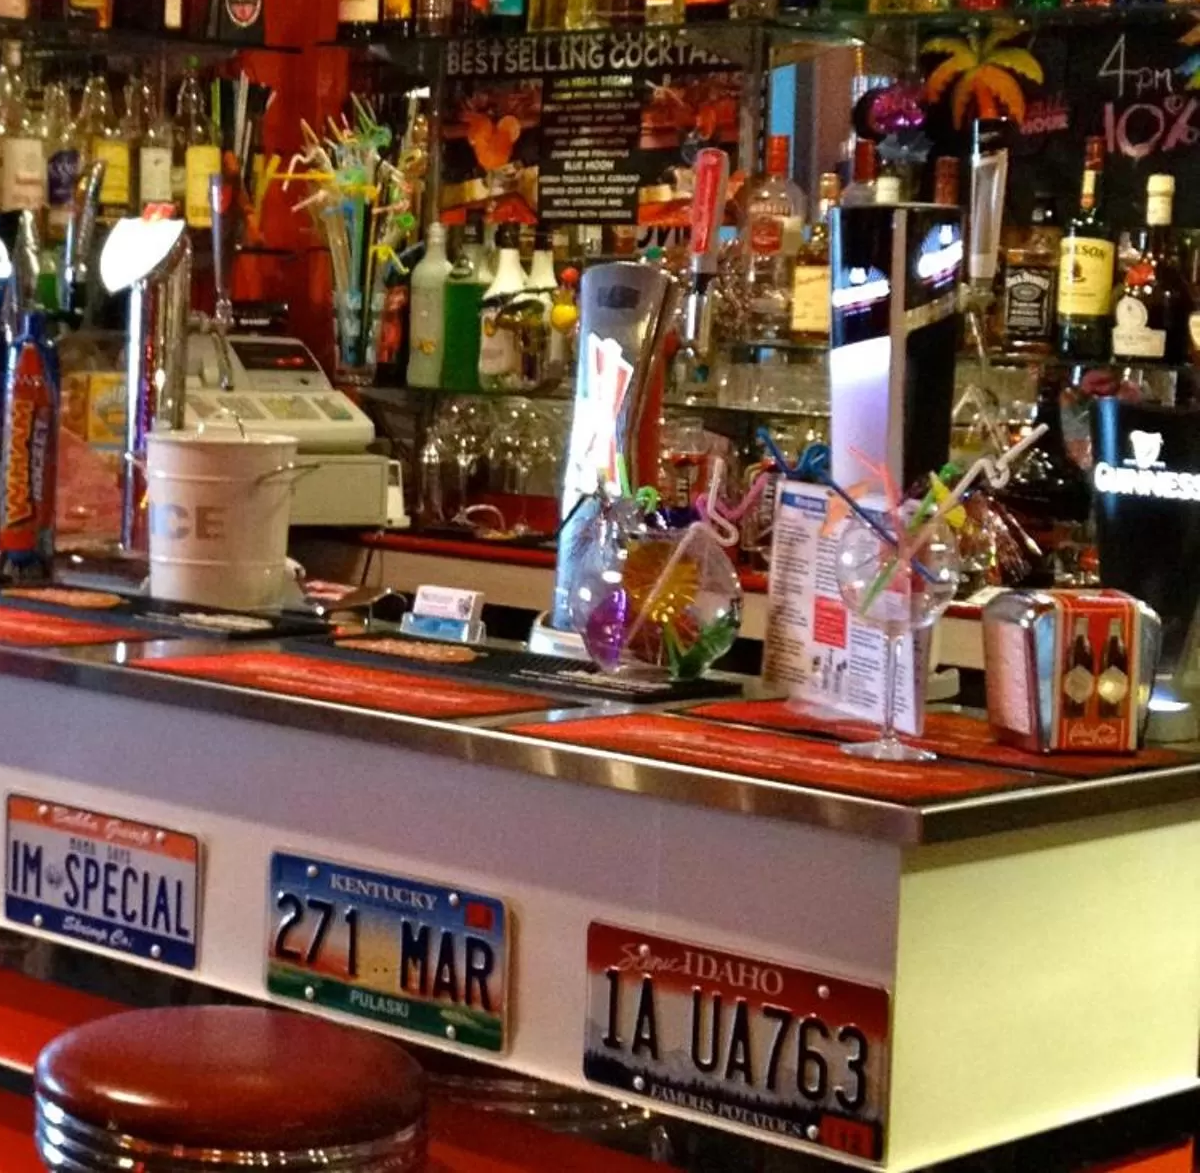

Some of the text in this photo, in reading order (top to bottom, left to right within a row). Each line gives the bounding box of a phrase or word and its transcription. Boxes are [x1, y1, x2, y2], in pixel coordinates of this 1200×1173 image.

[608, 38, 732, 69] COCKTA
[11, 840, 190, 938] IM SPECIAL
[330, 873, 438, 912] KENTUCKY
[275, 892, 495, 1012] 271 MAR
[683, 950, 784, 996] IDAHO
[350, 988, 409, 1019] PULASKI
[602, 968, 868, 1112] 1A UA763
[651, 1083, 803, 1138] FAMOUS POTATOES
